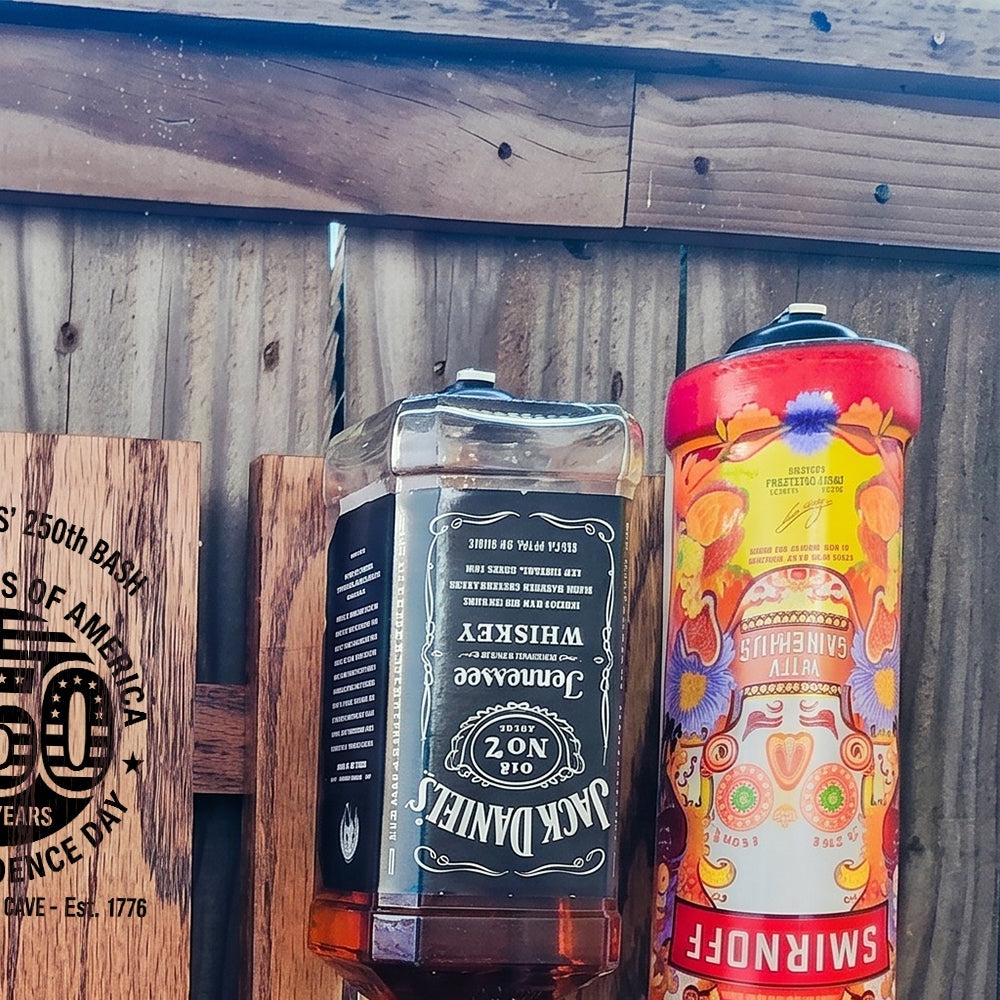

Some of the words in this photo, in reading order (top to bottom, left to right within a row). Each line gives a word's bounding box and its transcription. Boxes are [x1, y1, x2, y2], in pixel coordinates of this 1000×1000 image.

[22, 509, 89, 556] 250th
[88, 538, 149, 598] BASH
[27, 577, 67, 611] OF
[64, 601, 148, 728] AMERICA
[457, 622, 584, 647] WHISKEY
[81, 789, 130, 847] DAY
[535, 777, 612, 844] JACK
[4, 897, 46, 918] CAVE
[64, 898, 100, 919] Est.
[107, 898, 148, 918] 1776
[686, 922, 878, 974] SMIRNOFF
